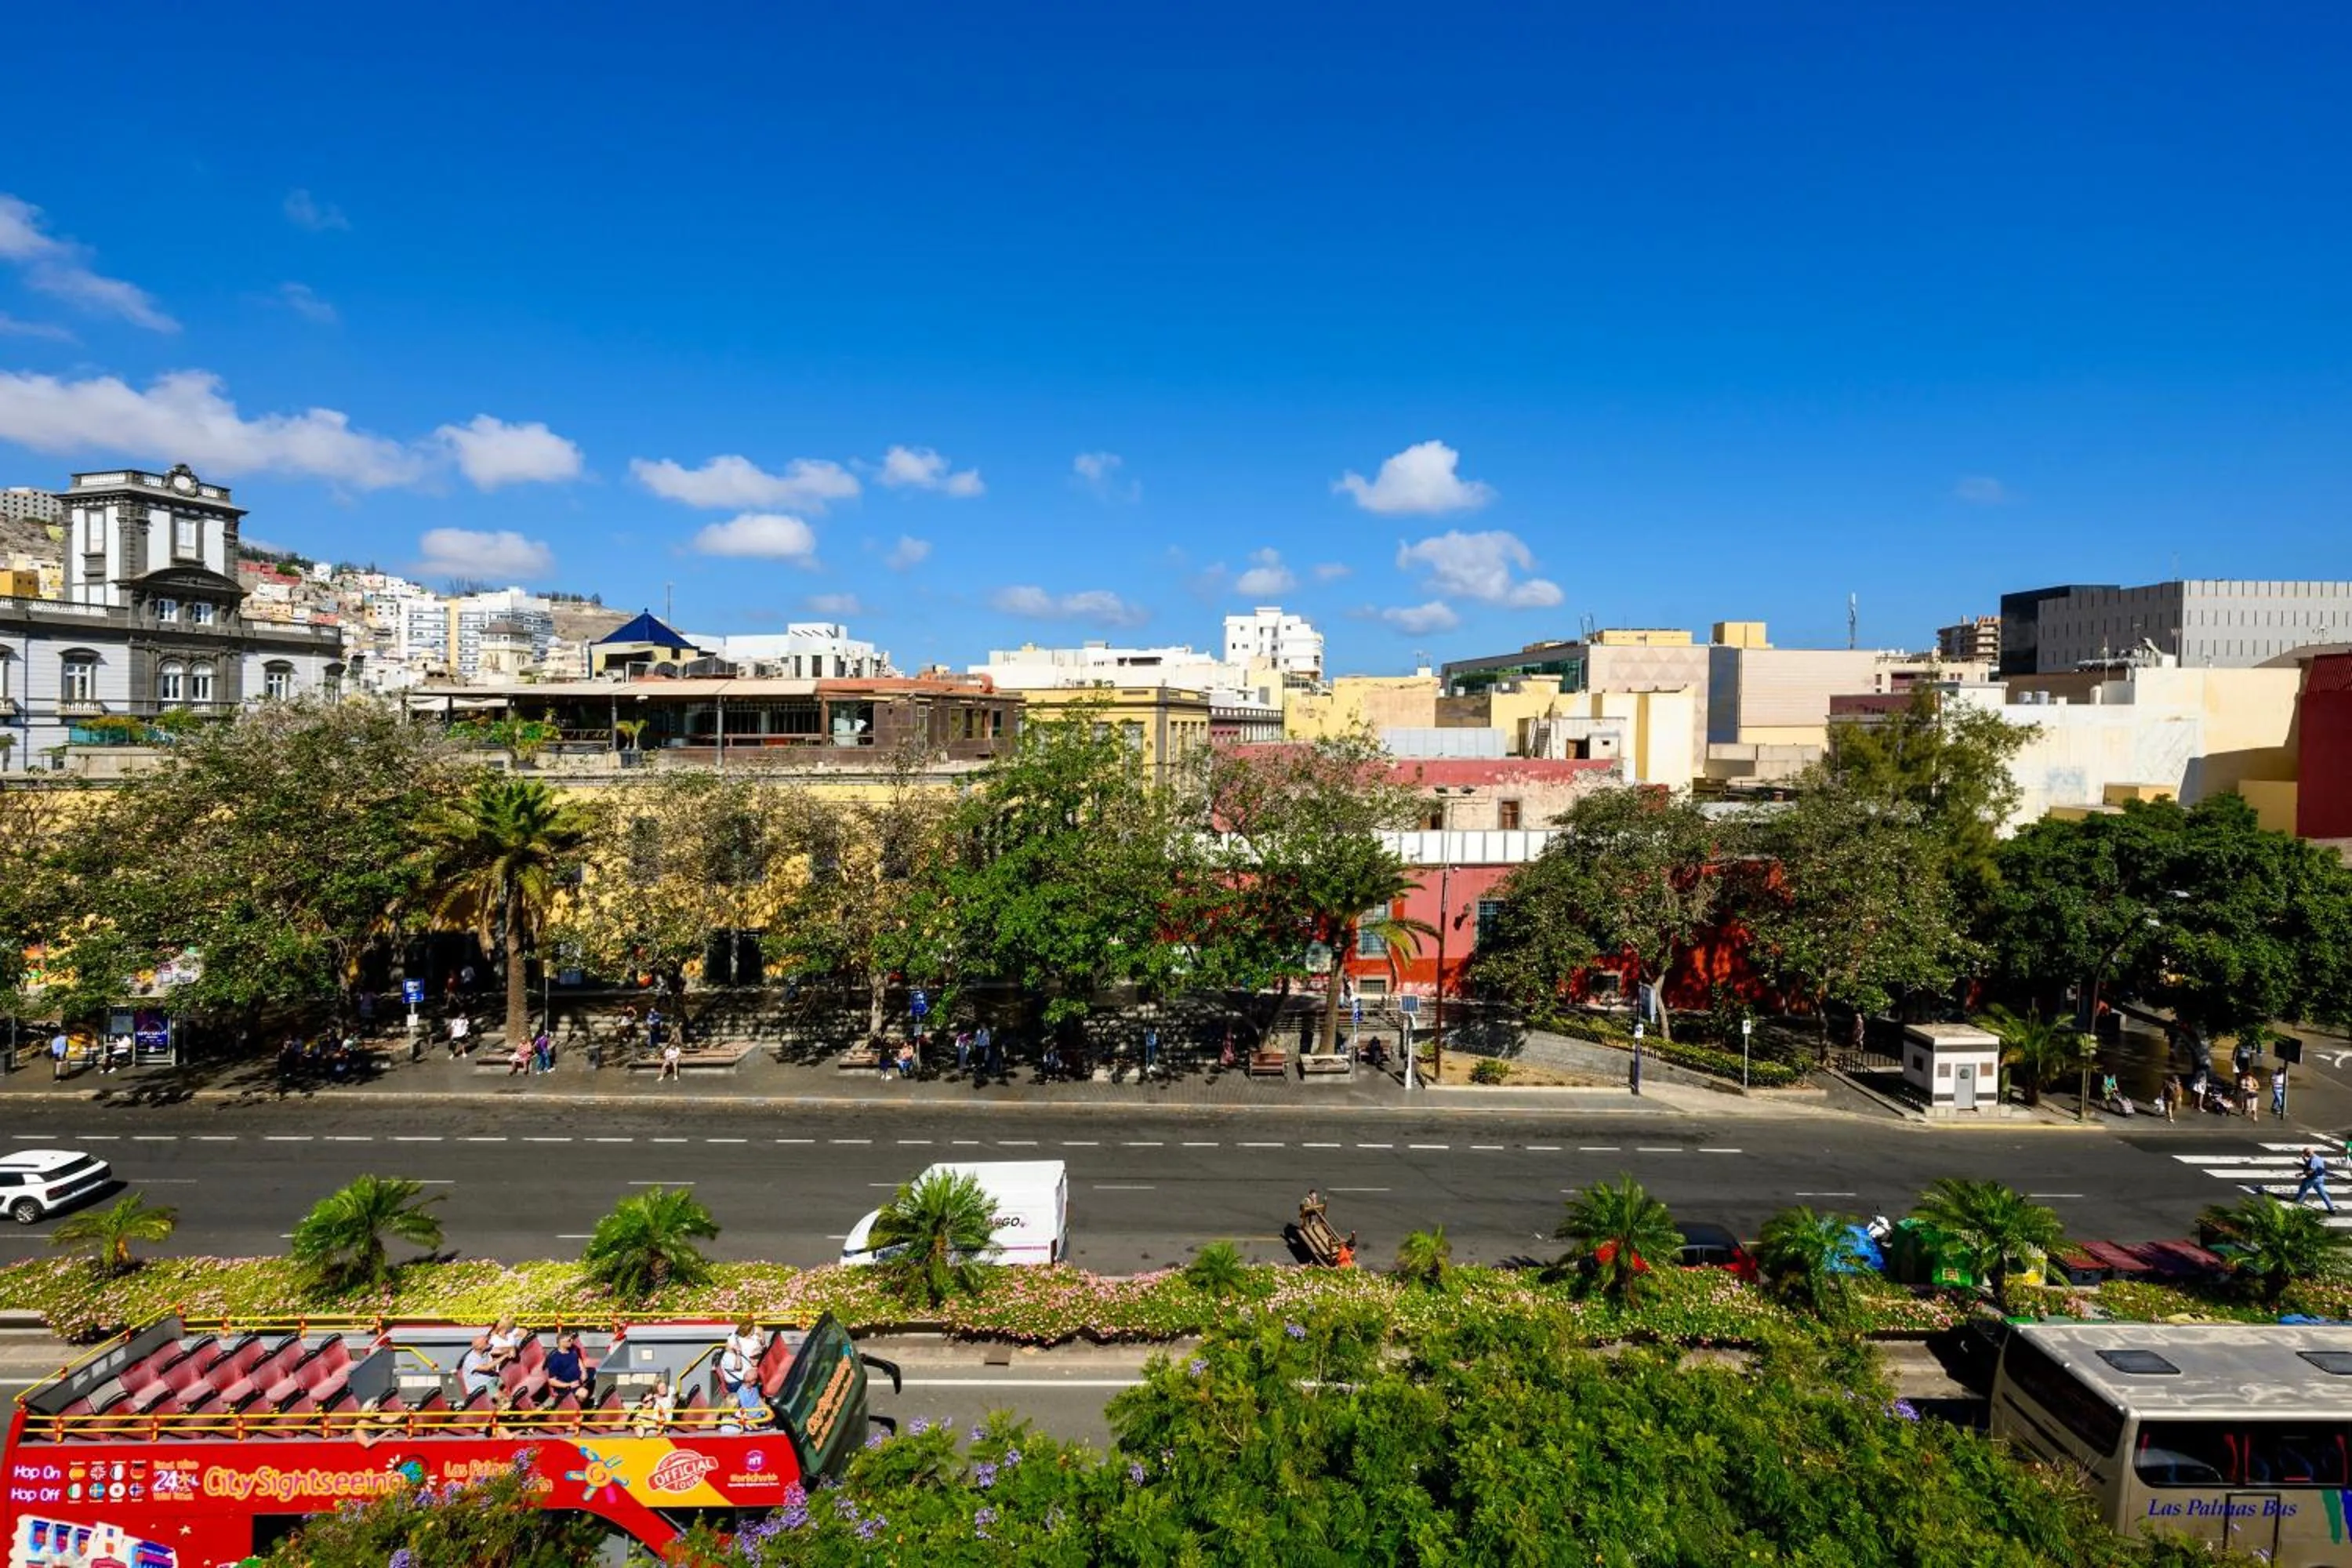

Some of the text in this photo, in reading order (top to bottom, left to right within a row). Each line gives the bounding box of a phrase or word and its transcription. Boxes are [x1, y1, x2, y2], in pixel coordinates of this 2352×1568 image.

[13, 1465, 61, 1480] Hop On
[444, 1459, 514, 1478] Las Palma
[654, 1459, 714, 1486] OFFICIAL
[674, 1475, 700, 1490] TOUR
[11, 1487, 60, 1503] Hop Off
[2148, 1498, 2298, 1517] Las Palmas Bus
